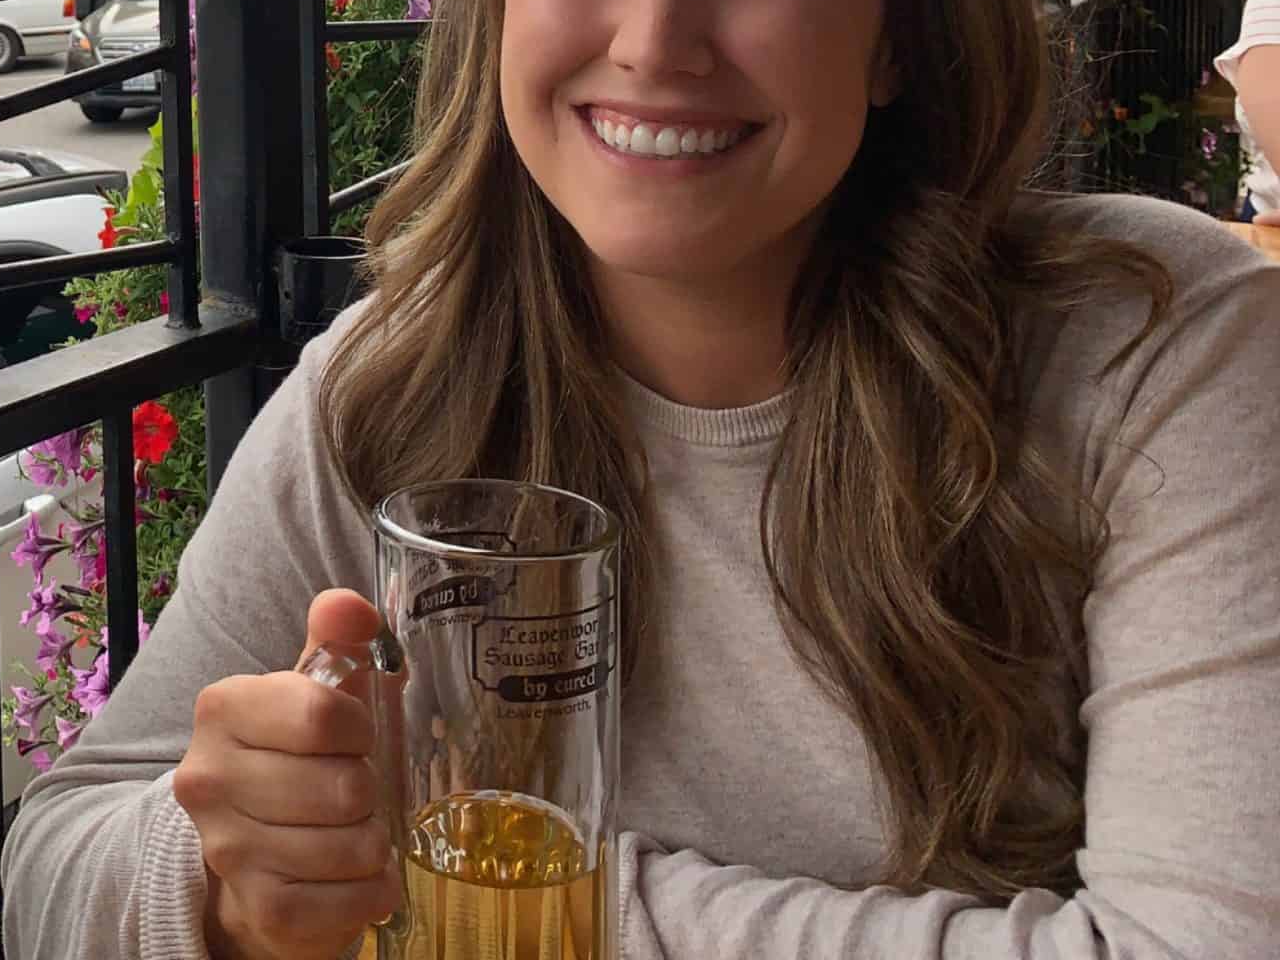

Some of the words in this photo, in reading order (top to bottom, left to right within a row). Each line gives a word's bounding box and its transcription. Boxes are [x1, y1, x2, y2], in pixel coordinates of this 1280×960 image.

[498, 618, 600, 645] Leavenwor
[483, 646, 564, 670] Sausage
[523, 677, 548, 700] by
[553, 667, 596, 694] cured
